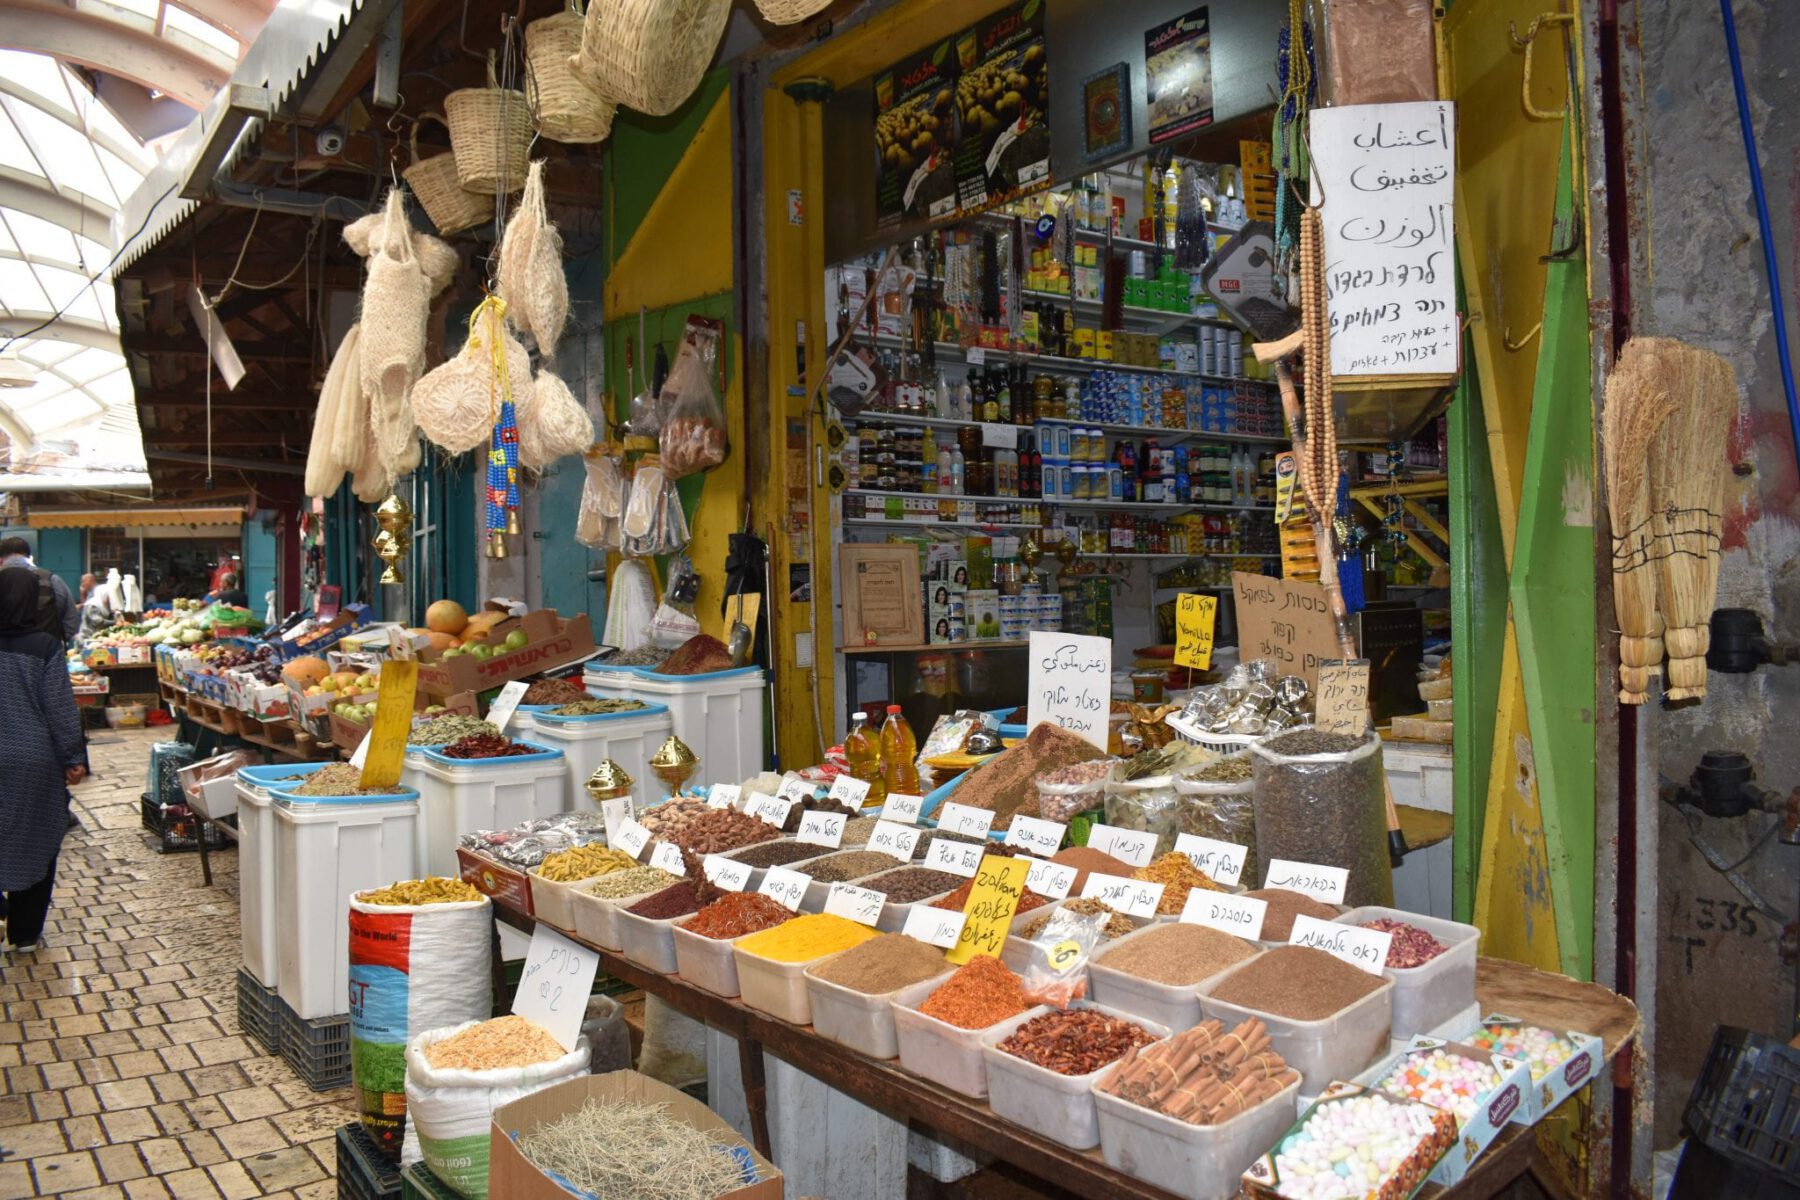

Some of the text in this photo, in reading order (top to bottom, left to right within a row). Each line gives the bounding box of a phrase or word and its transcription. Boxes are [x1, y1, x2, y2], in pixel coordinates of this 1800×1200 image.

[1353, 104, 1449, 152] أعشاب
[1340, 204, 1447, 248] الوزن
[1325, 251, 1444, 301] לרדת בגדול
[1343, 302, 1401, 332] צמחים
[1279, 591, 1328, 614] כוסות
[1028, 865, 1052, 882] לפר
